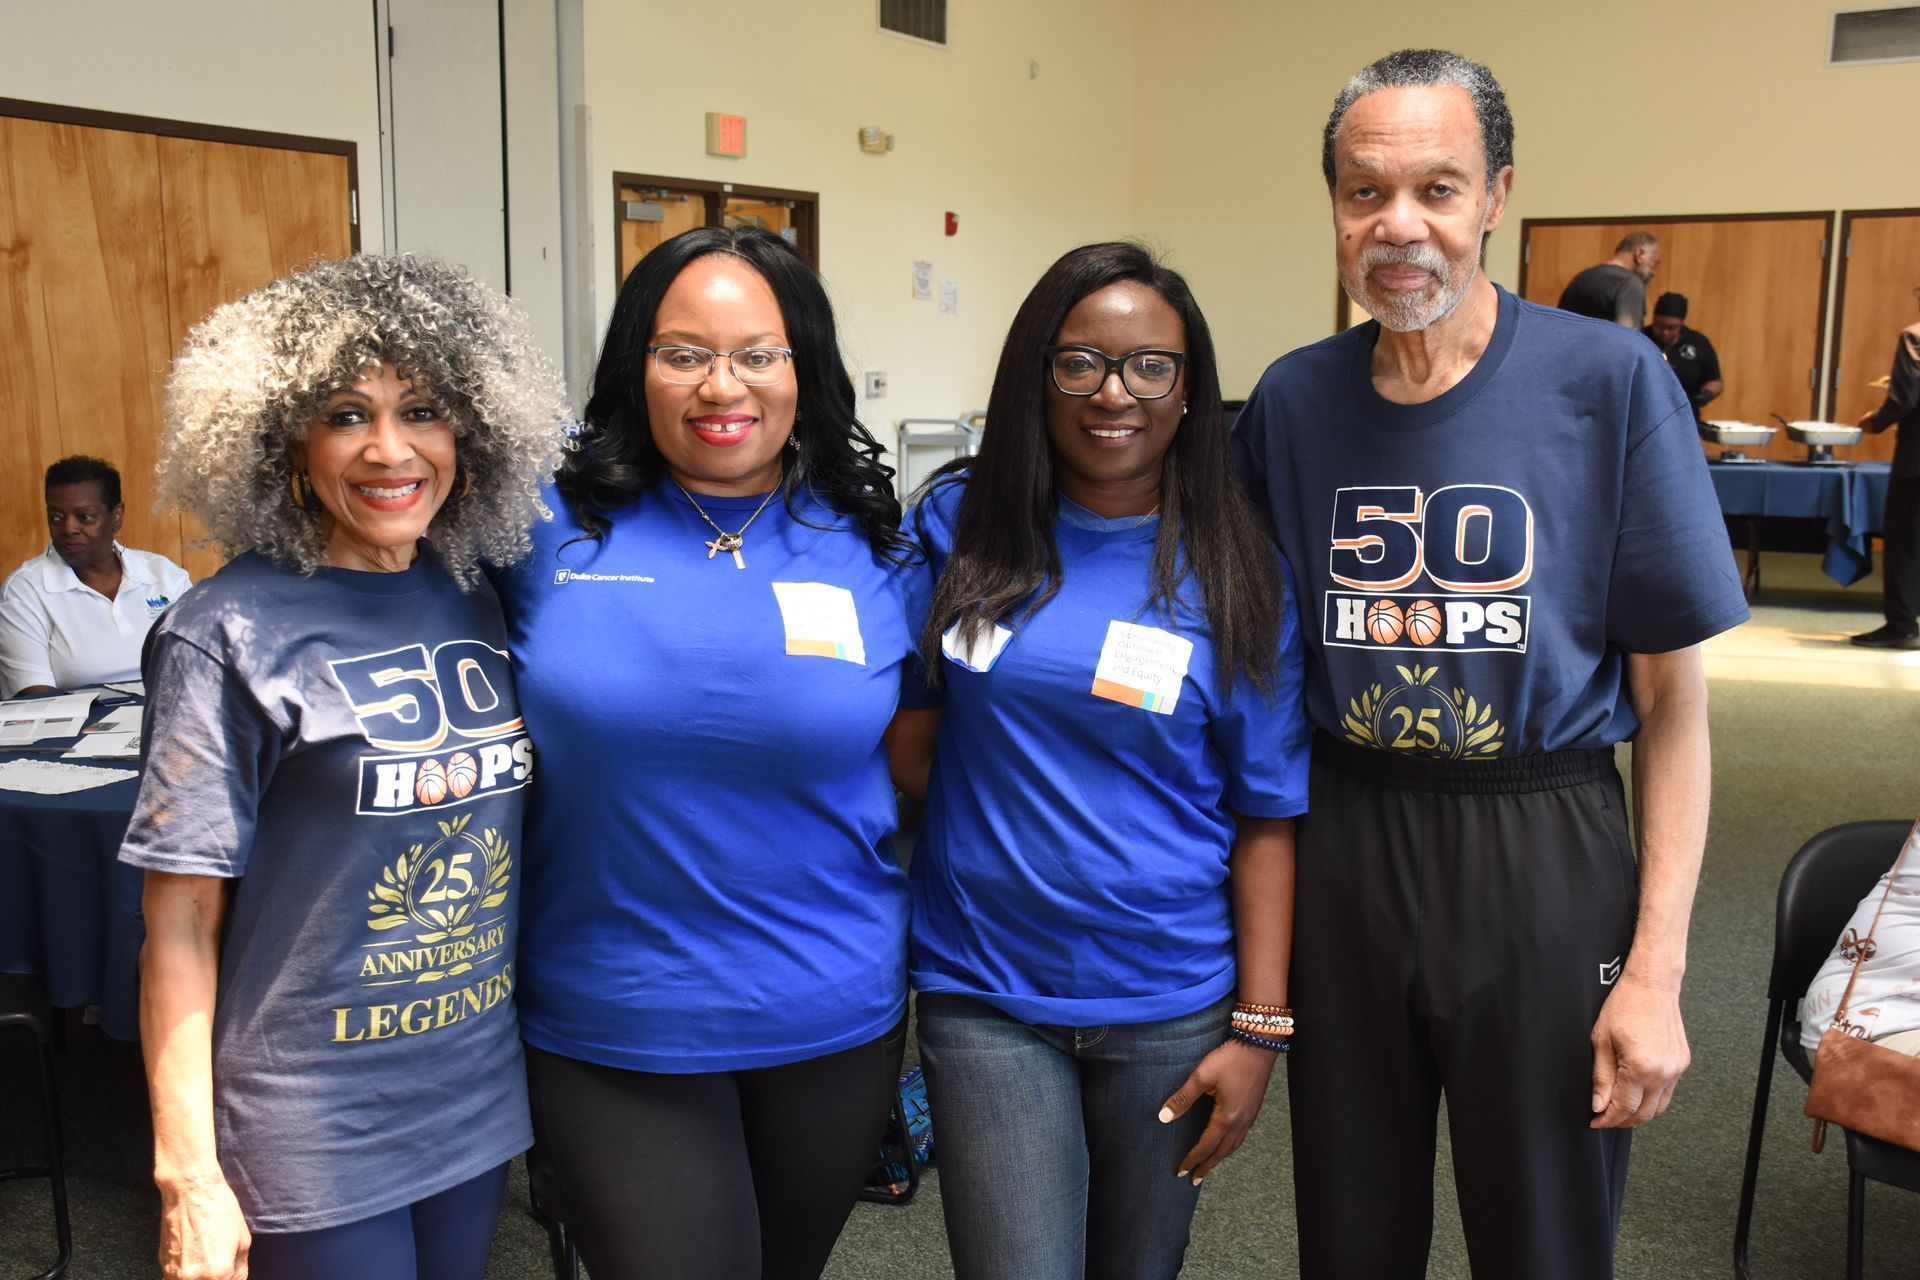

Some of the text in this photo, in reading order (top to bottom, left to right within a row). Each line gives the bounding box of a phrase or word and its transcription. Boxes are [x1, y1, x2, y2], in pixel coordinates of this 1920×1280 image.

[1329, 484, 1534, 592] 50
[570, 572, 655, 583] Duke Cancer Institute
[1335, 598, 1523, 646] HOOPS
[328, 640, 524, 752] 50
[1111, 664, 1163, 685] and Equity
[373, 737, 534, 808] HOOPS
[359, 922, 508, 977] ANNIVERSARY
[331, 963, 513, 1042] LEGENDS
